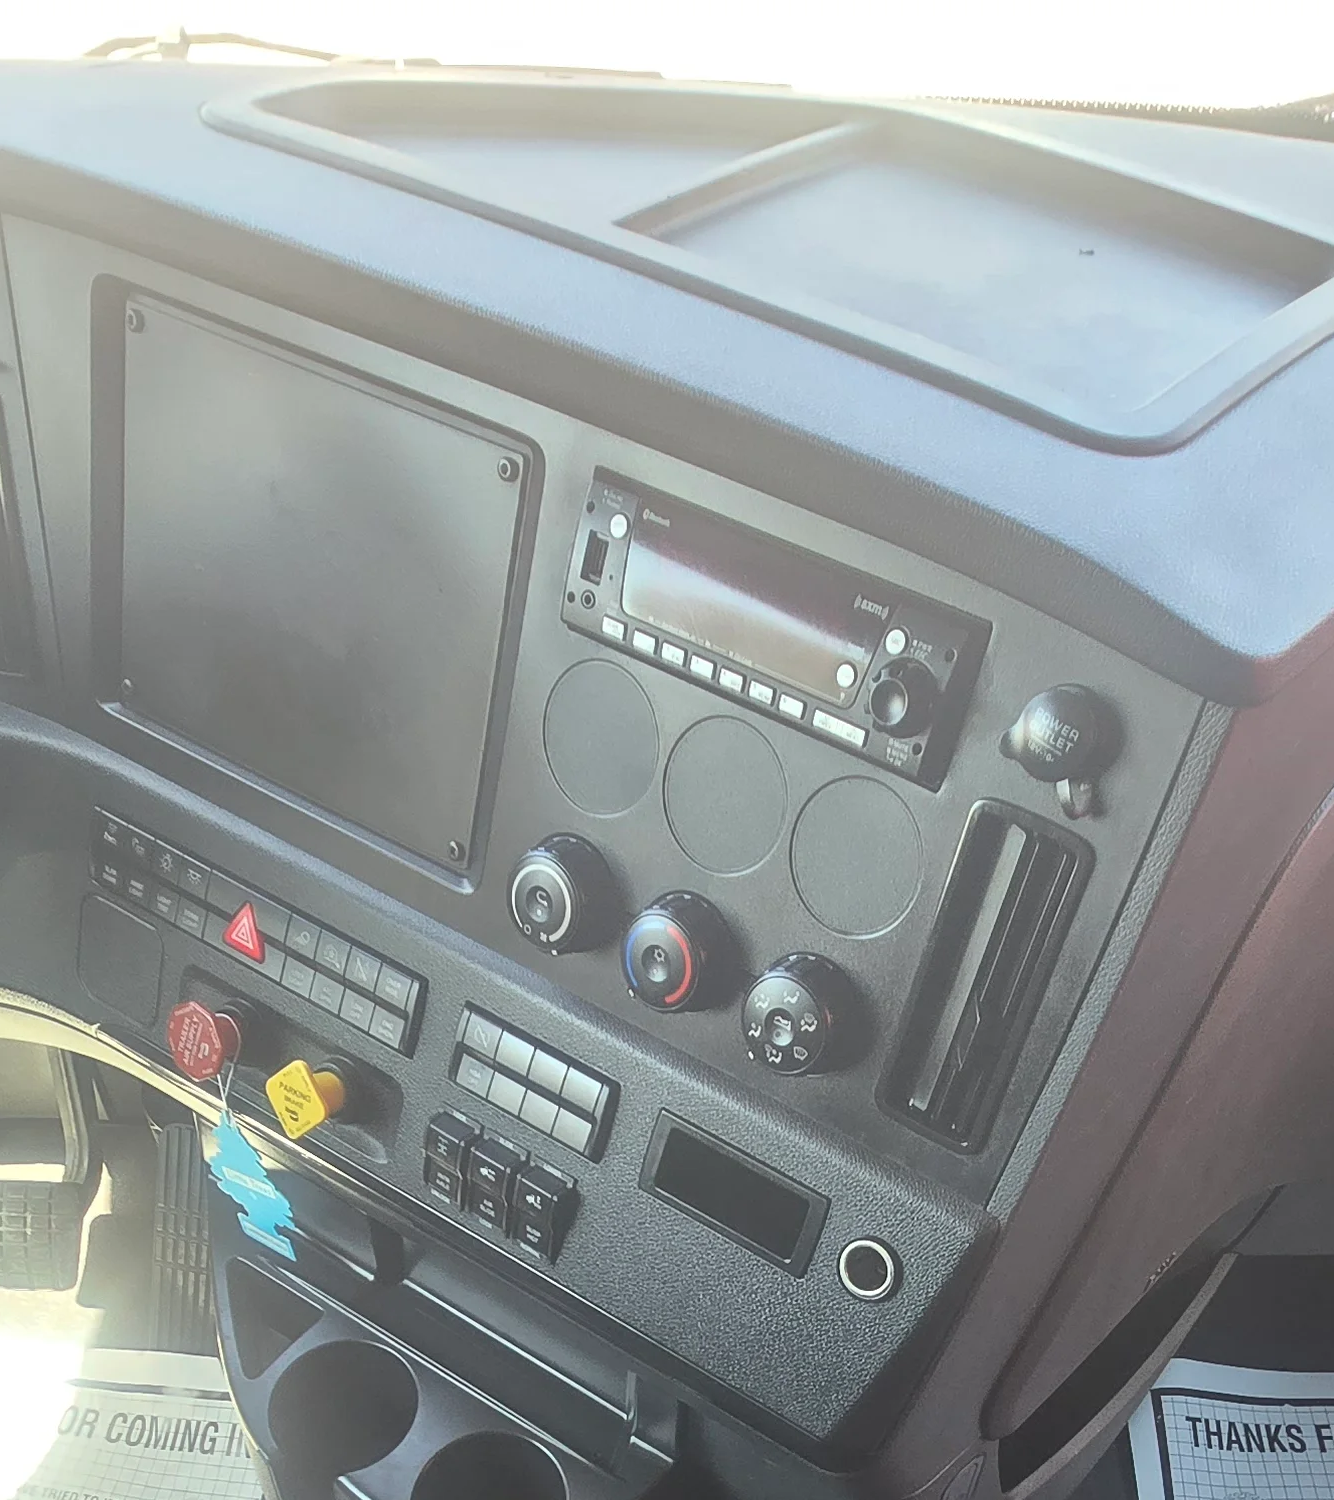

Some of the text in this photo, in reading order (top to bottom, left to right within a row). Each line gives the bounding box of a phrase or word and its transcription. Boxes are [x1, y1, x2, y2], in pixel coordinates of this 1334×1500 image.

[1034, 706, 1079, 742] POWER
[177, 1017, 191, 1052] TRAILER
[58, 1405, 100, 1439] OR
[105, 1412, 219, 1455] COMING
[1185, 1416, 1307, 1453] THANKS
